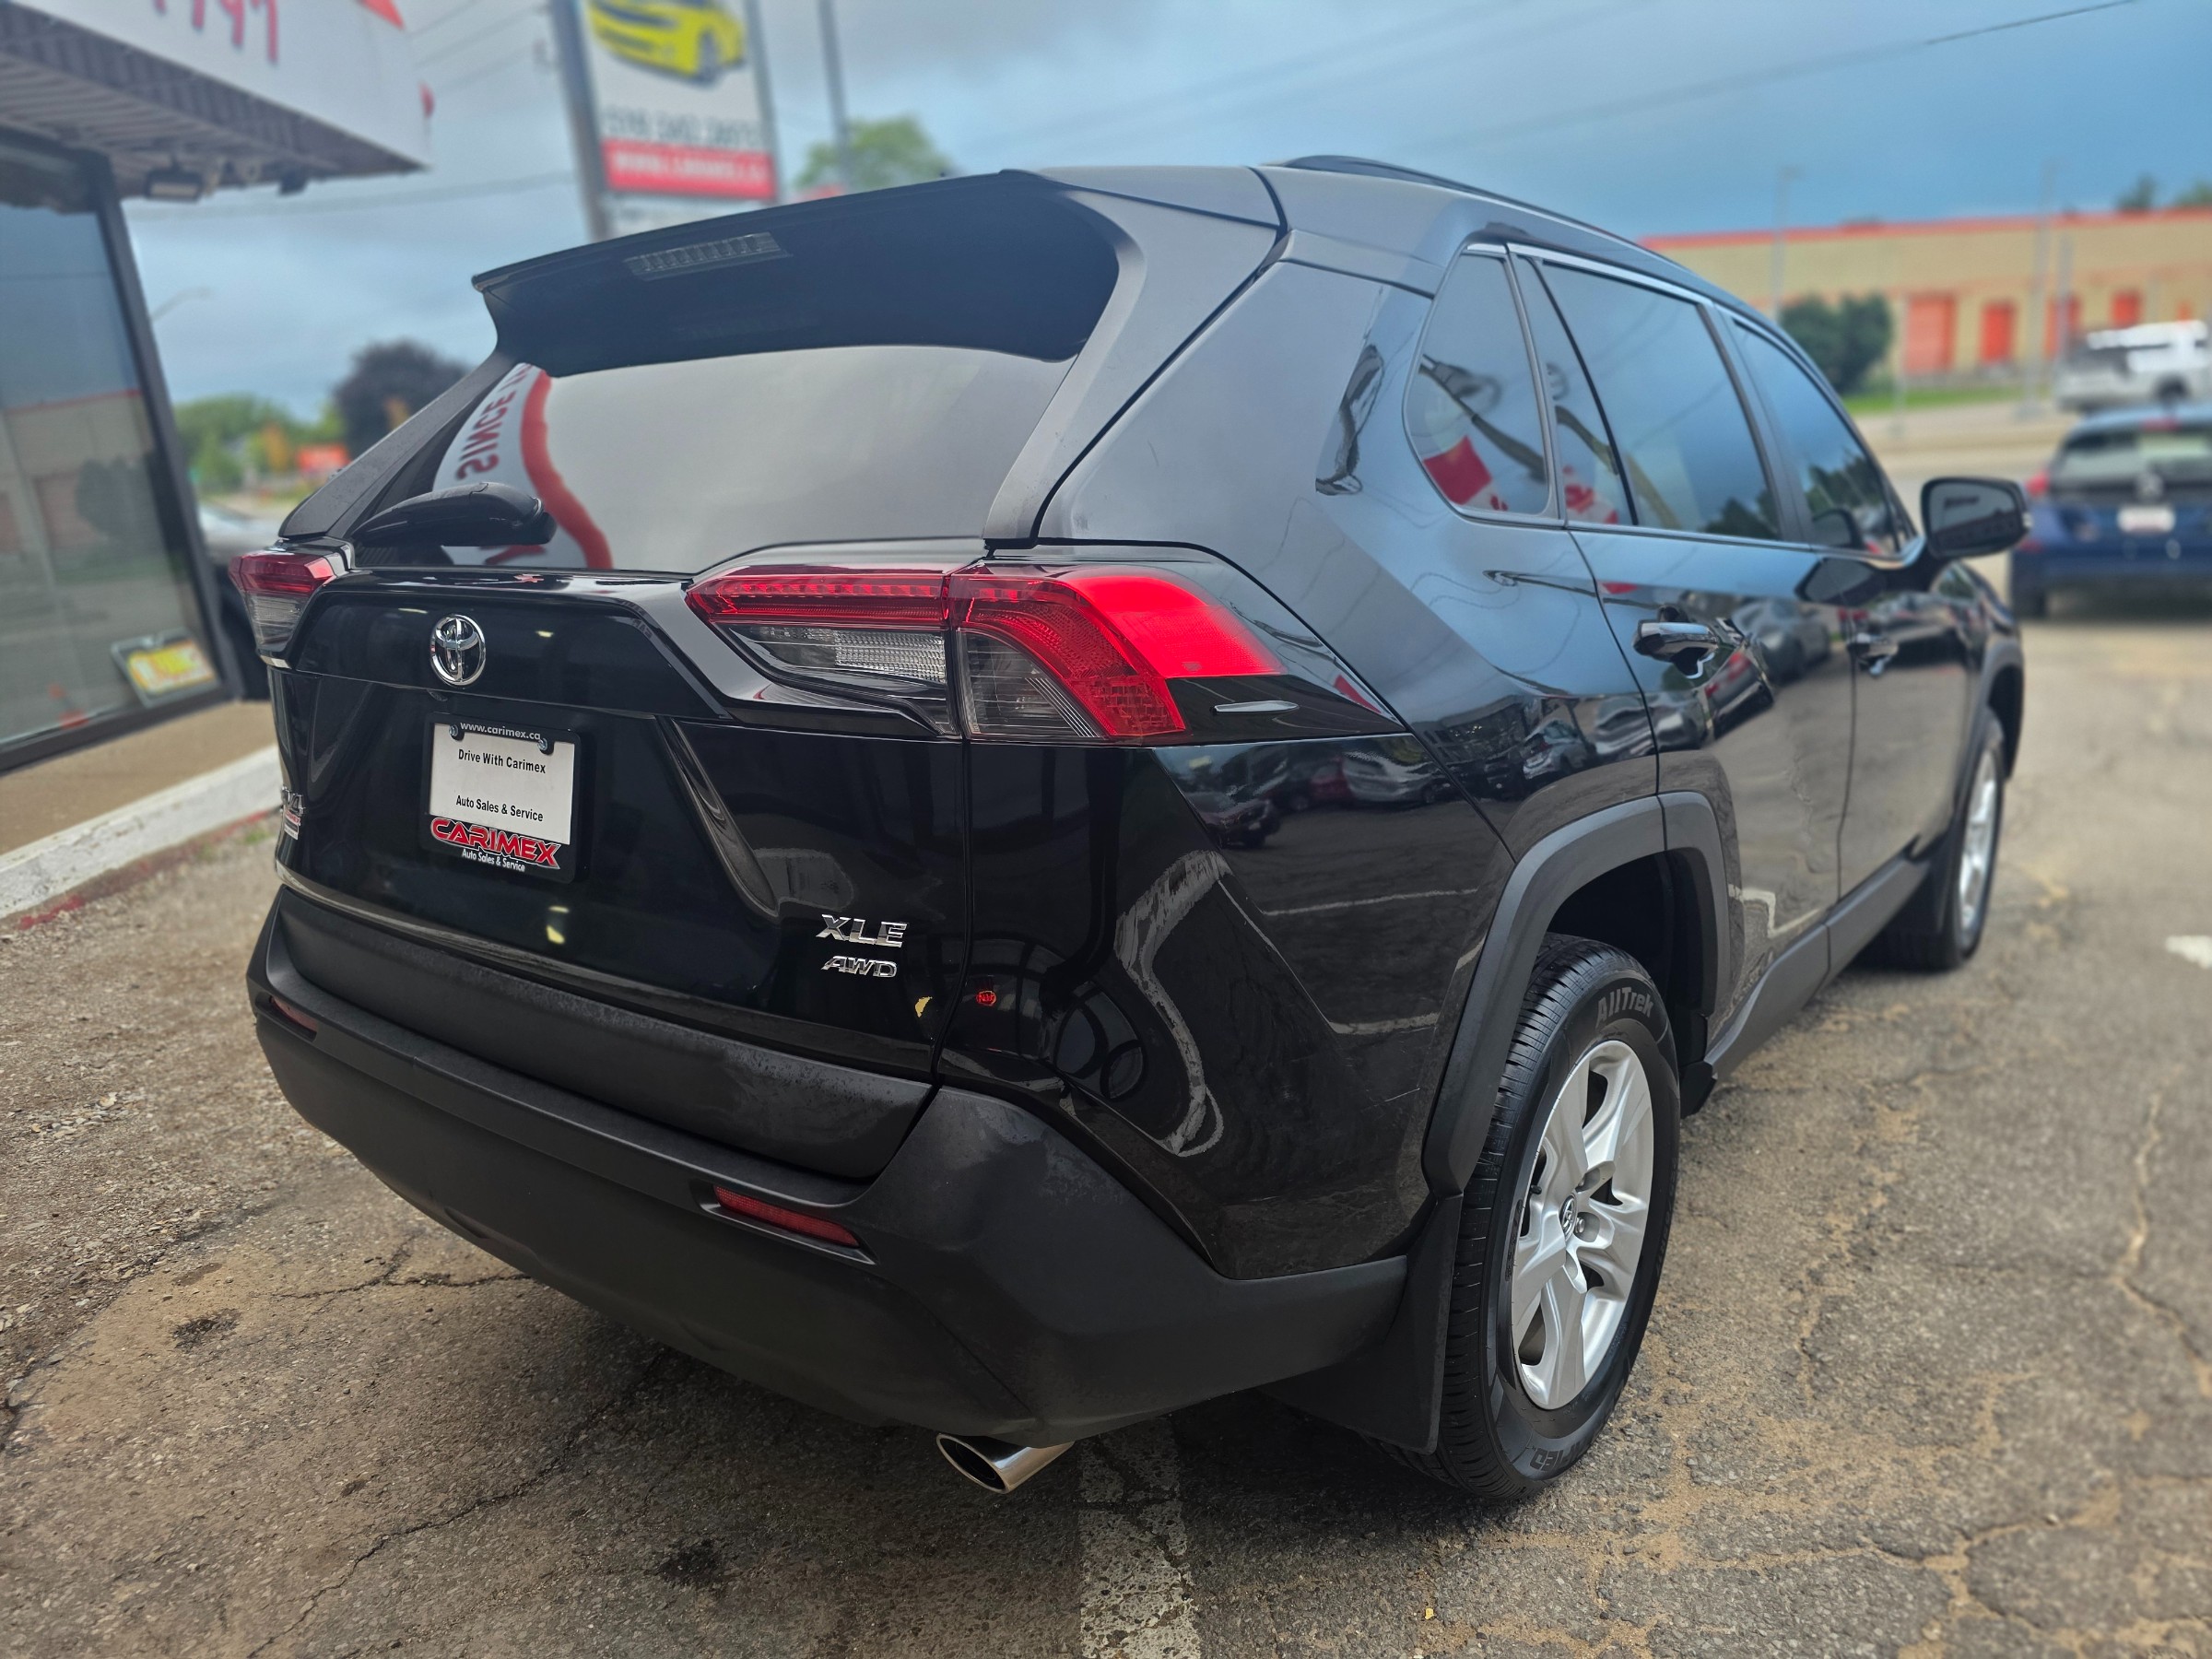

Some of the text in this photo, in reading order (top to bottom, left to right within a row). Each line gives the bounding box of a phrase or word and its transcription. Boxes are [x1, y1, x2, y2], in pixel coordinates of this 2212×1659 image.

[460, 722, 541, 740] www.carimex.ca
[458, 748, 547, 774] Drive With Carimex
[456, 794, 544, 822] Auto Sales & Service
[430, 818, 561, 869] CARIMEX
[462, 848, 525, 873] Auto Sales & Service
[816, 913, 908, 947] XLE
[820, 955, 898, 978] AWD
[1595, 986, 1654, 1029] AllTrek
